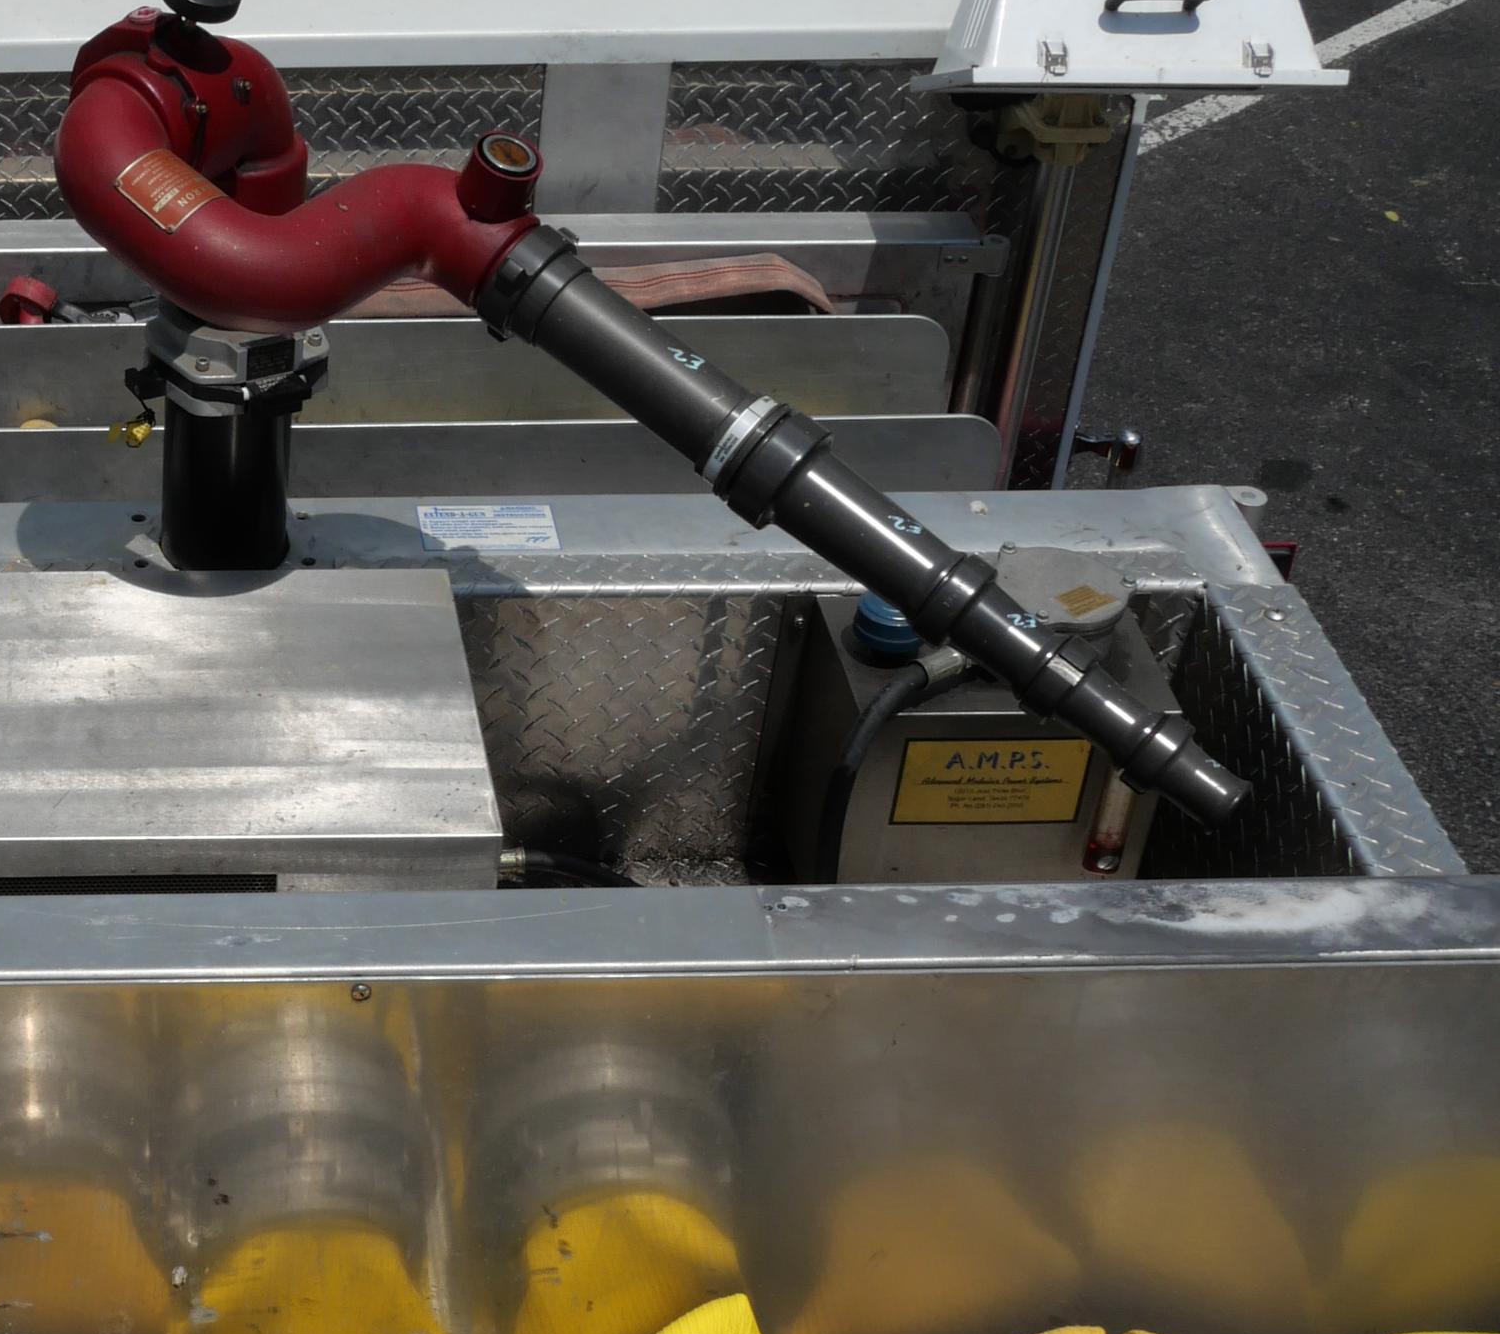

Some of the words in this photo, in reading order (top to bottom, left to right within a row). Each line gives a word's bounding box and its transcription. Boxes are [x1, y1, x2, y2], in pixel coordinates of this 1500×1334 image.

[667, 346, 705, 371] E2
[888, 514, 924, 535] E2
[1006, 612, 1037, 630] E2
[945, 750, 1051, 770] A.M.P.S.
